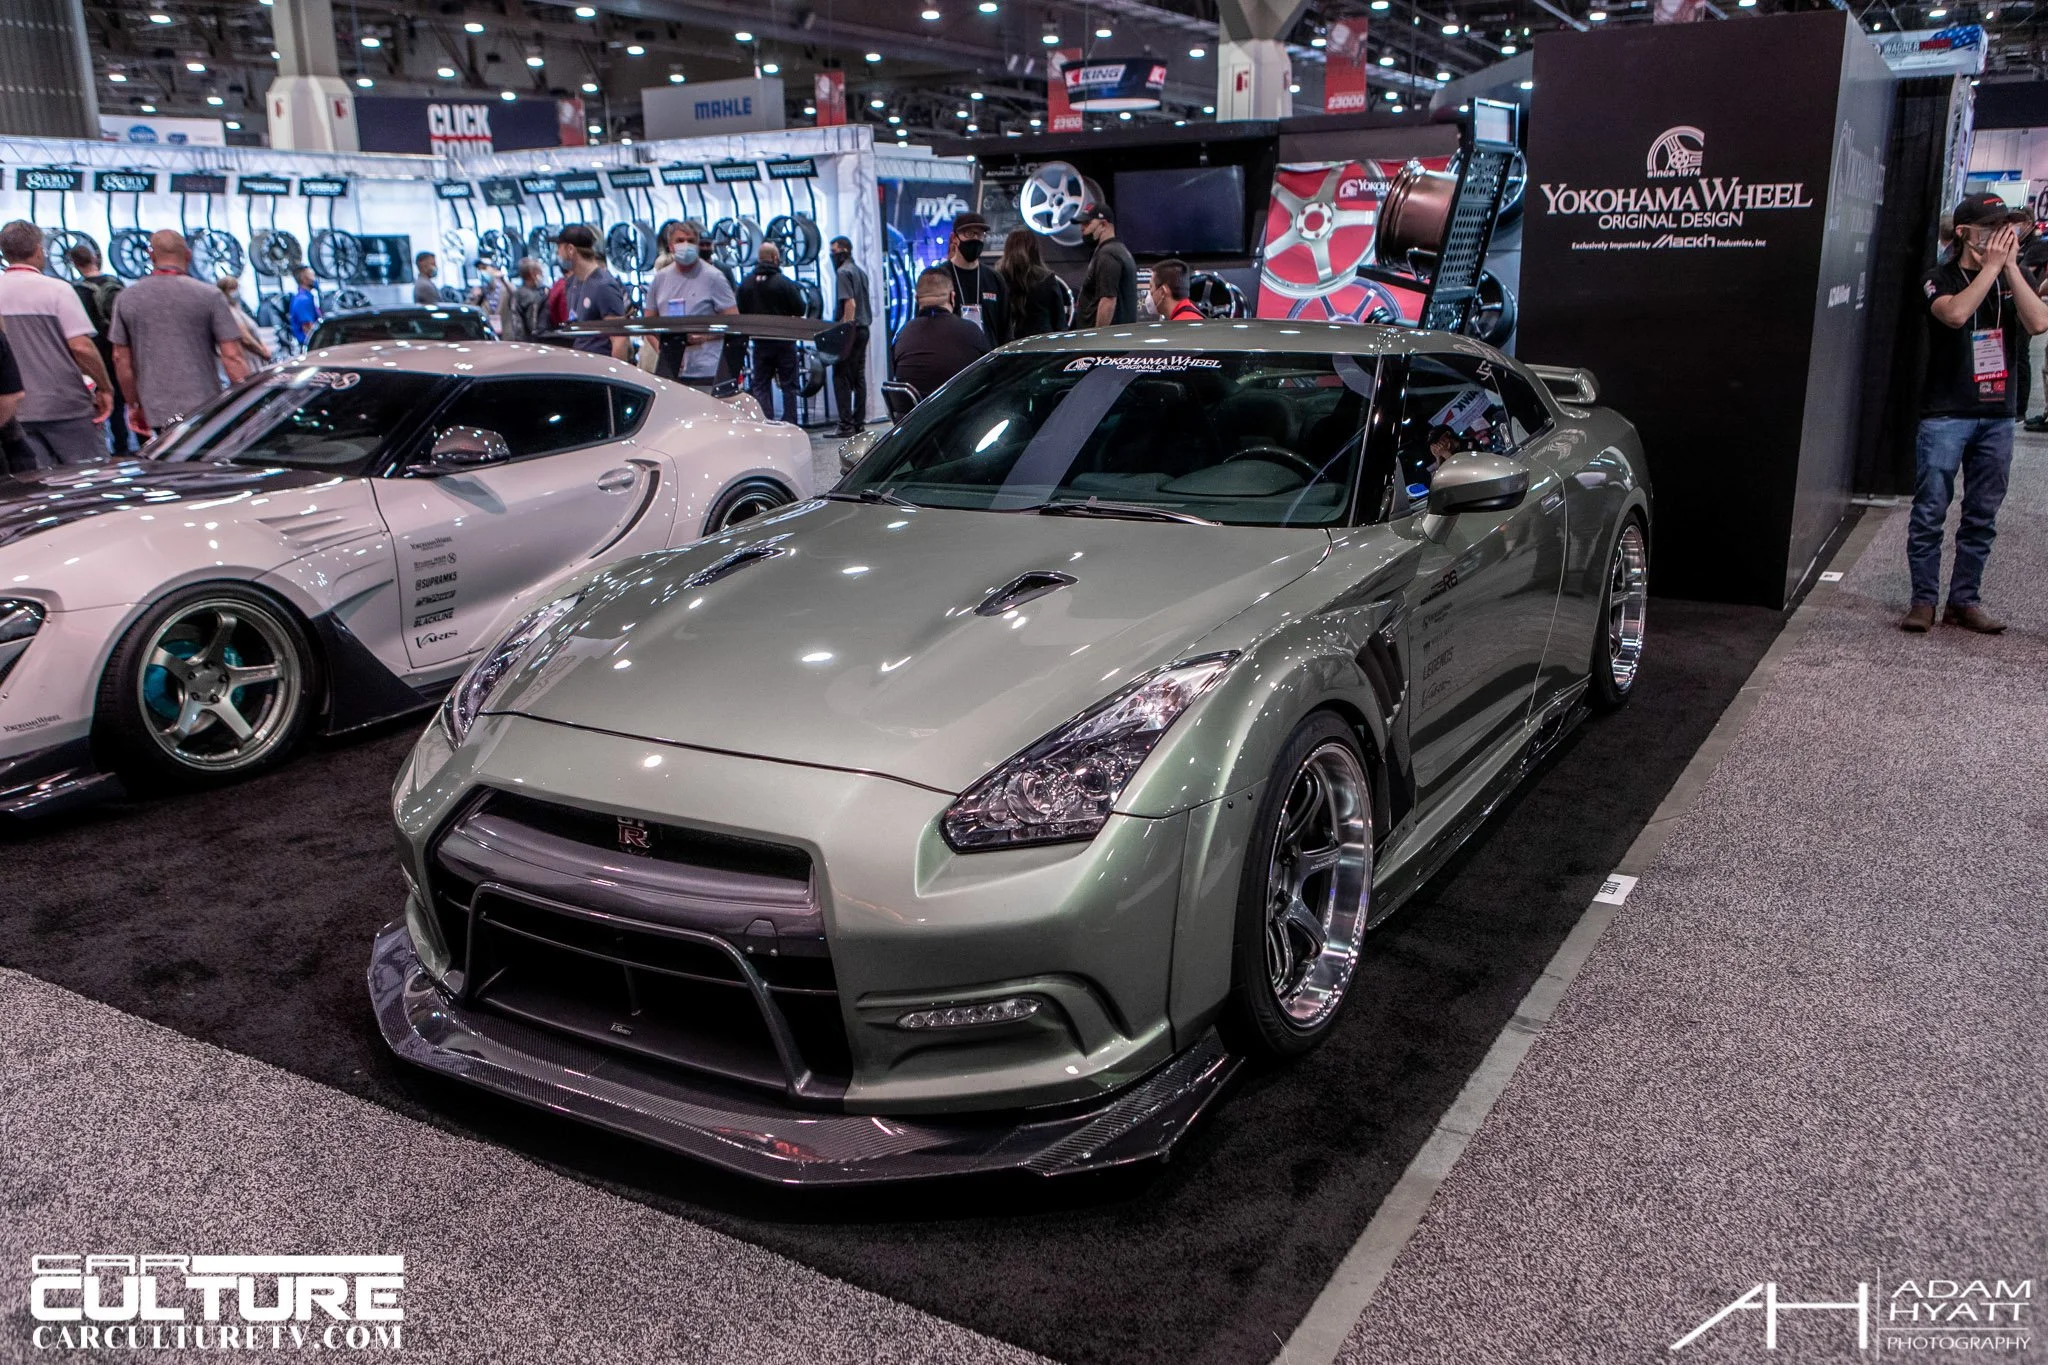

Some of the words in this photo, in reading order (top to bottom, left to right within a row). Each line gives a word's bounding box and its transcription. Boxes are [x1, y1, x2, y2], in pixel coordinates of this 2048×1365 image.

[1081, 68, 1120, 80] KING
[694, 96, 752, 120] MAHLE
[427, 104, 492, 137] CLICK
[1647, 169, 1676, 178] since
[1678, 167, 1701, 177] 1974
[1540, 183, 1701, 215] YOKOHAMA
[1698, 177, 1814, 211] WHEEL
[1598, 212, 1677, 230] ORIGINAL
[1680, 211, 1744, 228] DESIGN
[1571, 241, 1609, 251] Exclusively
[1609, 240, 1641, 251] Imported
[1641, 239, 1651, 251] by
[1095, 356, 1168, 366] YOKOHAMA
[1171, 356, 1223, 369] WHEEL
[1156, 364, 1187, 372] DESIGN
[618, 824, 650, 848] R
